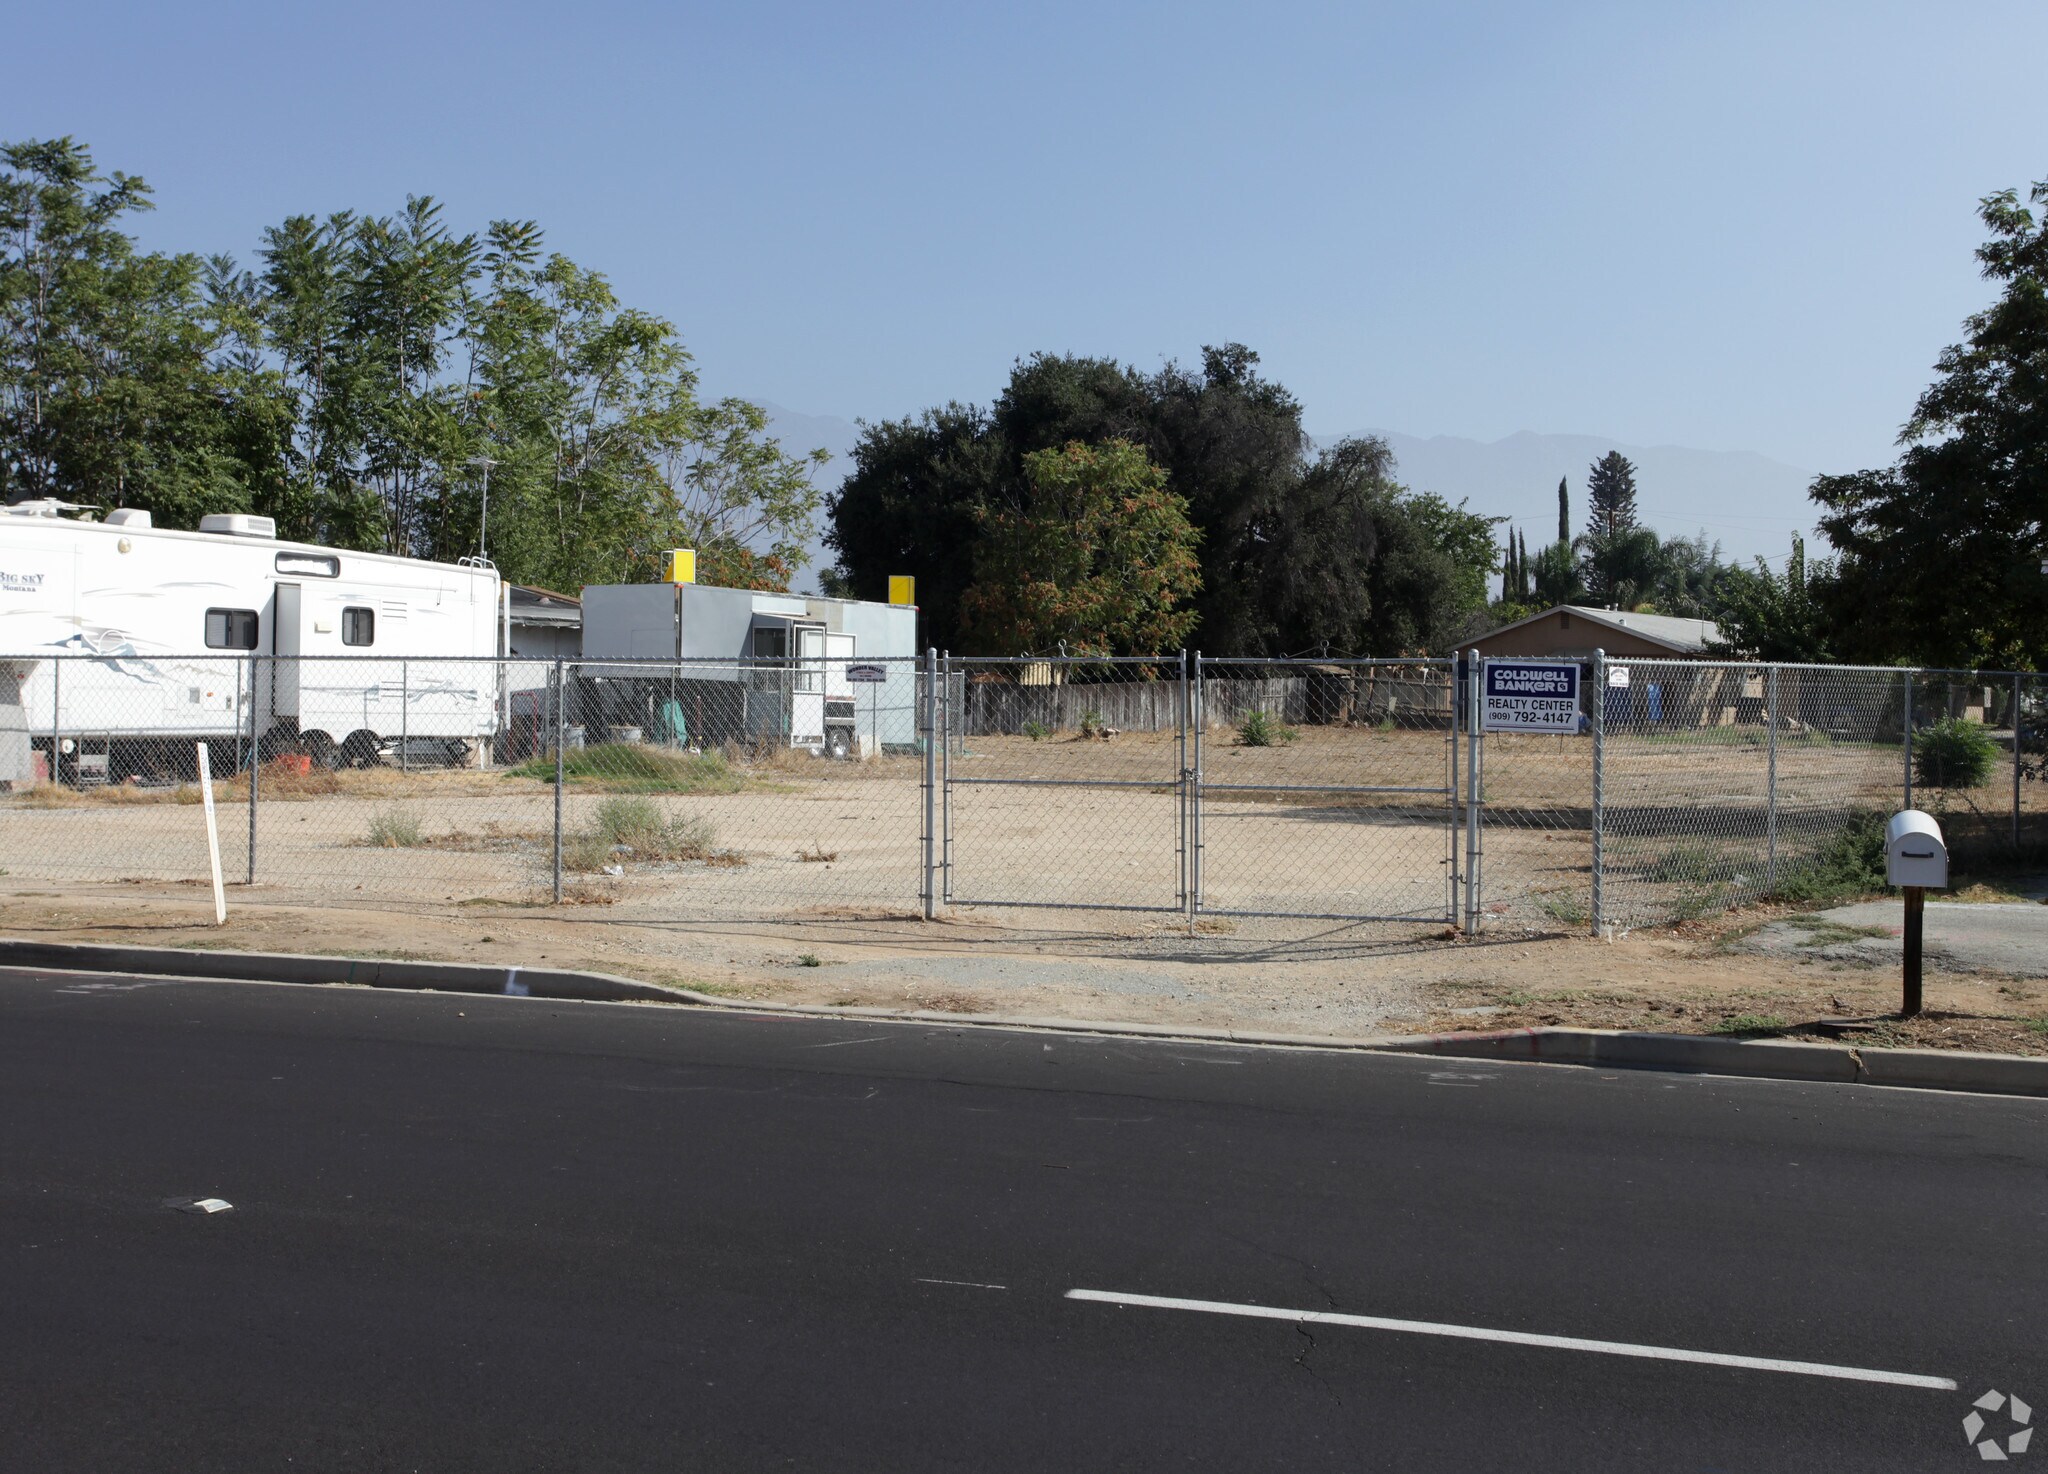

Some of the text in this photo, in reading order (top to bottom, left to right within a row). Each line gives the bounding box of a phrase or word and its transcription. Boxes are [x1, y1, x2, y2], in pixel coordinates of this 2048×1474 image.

[3, 584, 36, 592] Montana
[847, 665, 868, 674] WONDER
[868, 665, 884, 674] VALLEY
[1494, 669, 1569, 682] COLDWELL
[1494, 680, 1556, 693] BANKER
[1488, 698, 1574, 711] REALTY CENTER
[1488, 711, 1572, 724] (909) 792-4147
